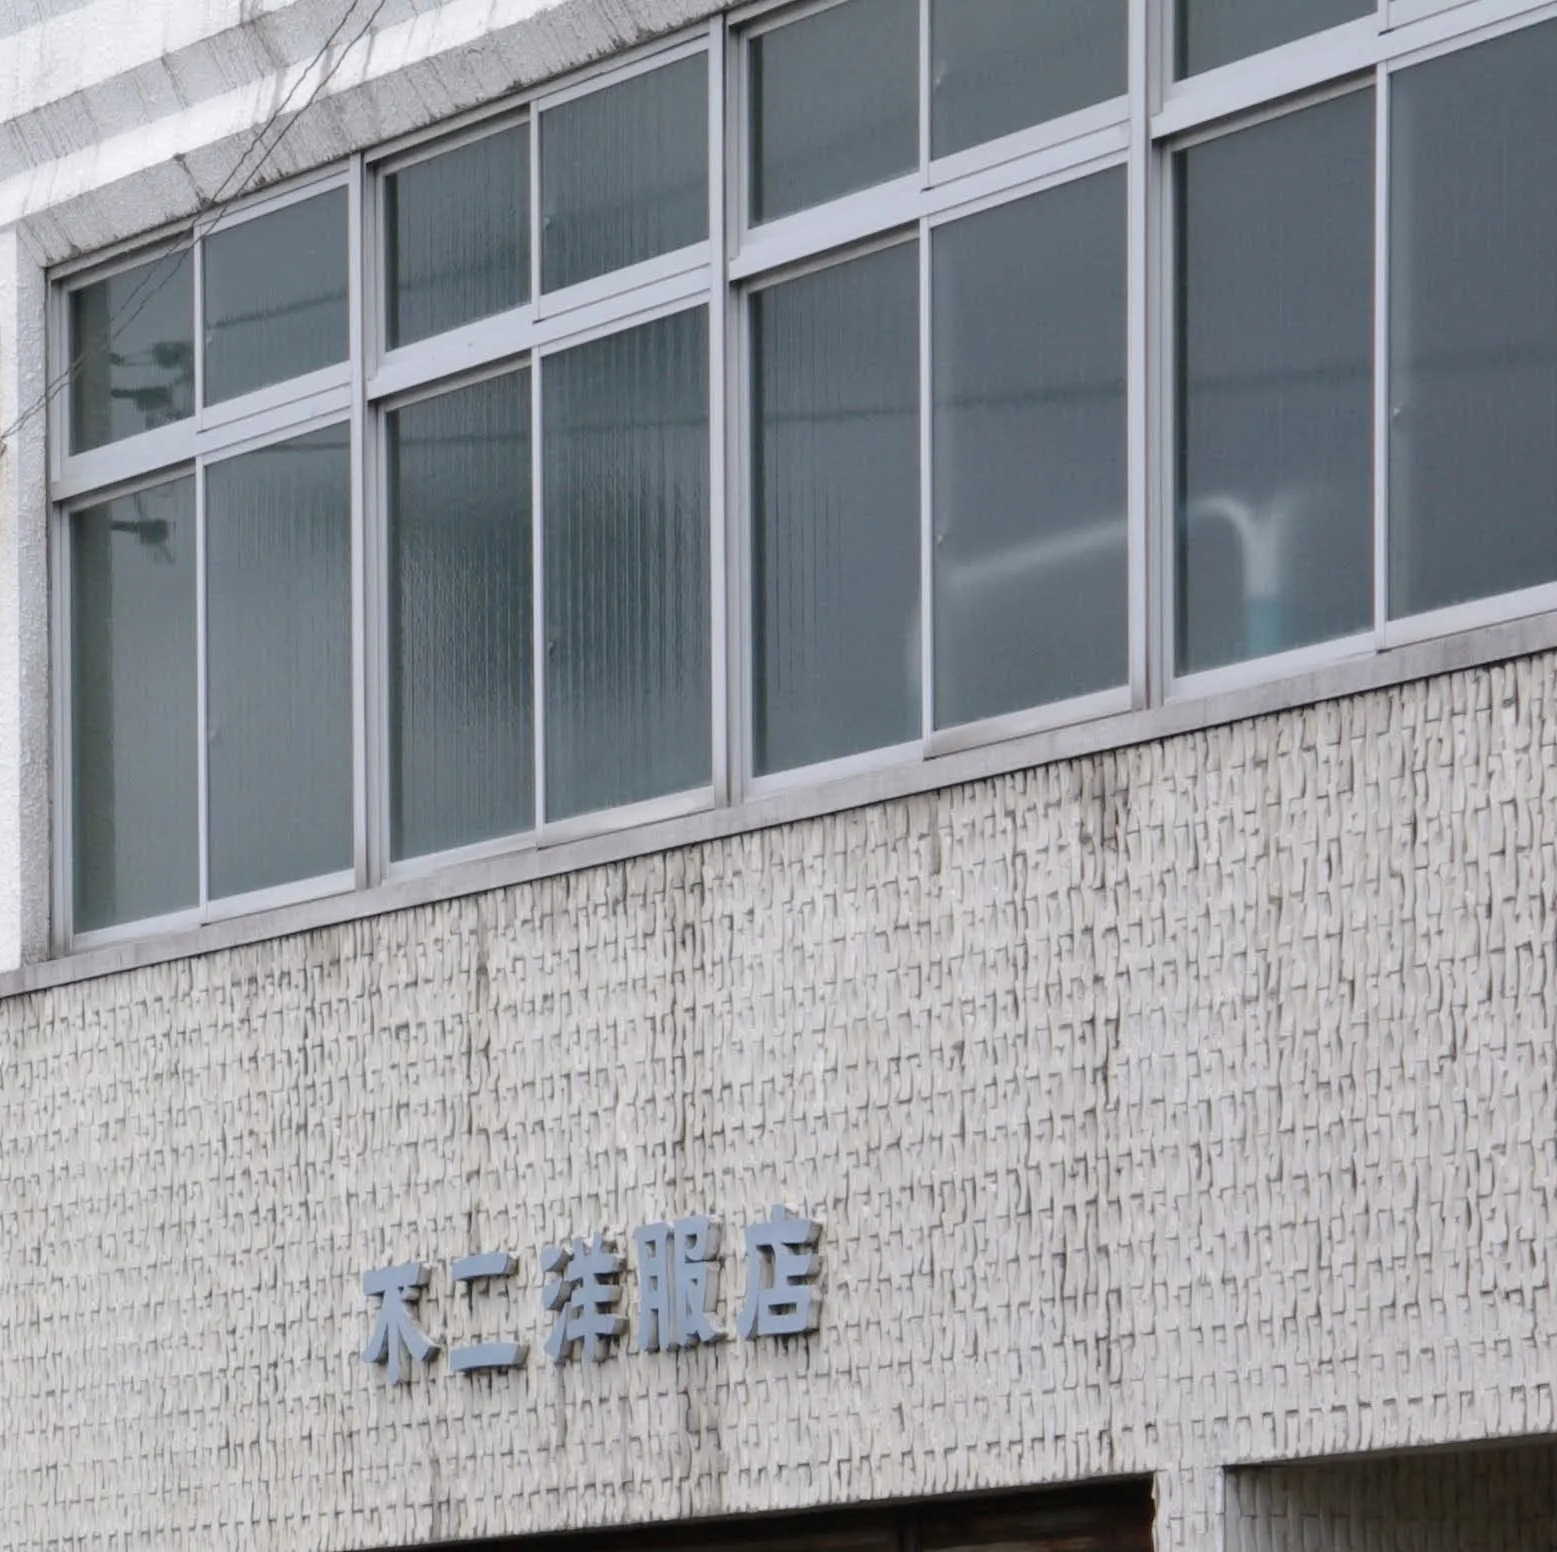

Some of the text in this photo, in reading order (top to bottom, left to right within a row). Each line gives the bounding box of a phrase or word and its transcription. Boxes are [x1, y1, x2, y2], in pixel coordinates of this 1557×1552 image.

[361, 1204, 823, 1386] 不二洋服店
